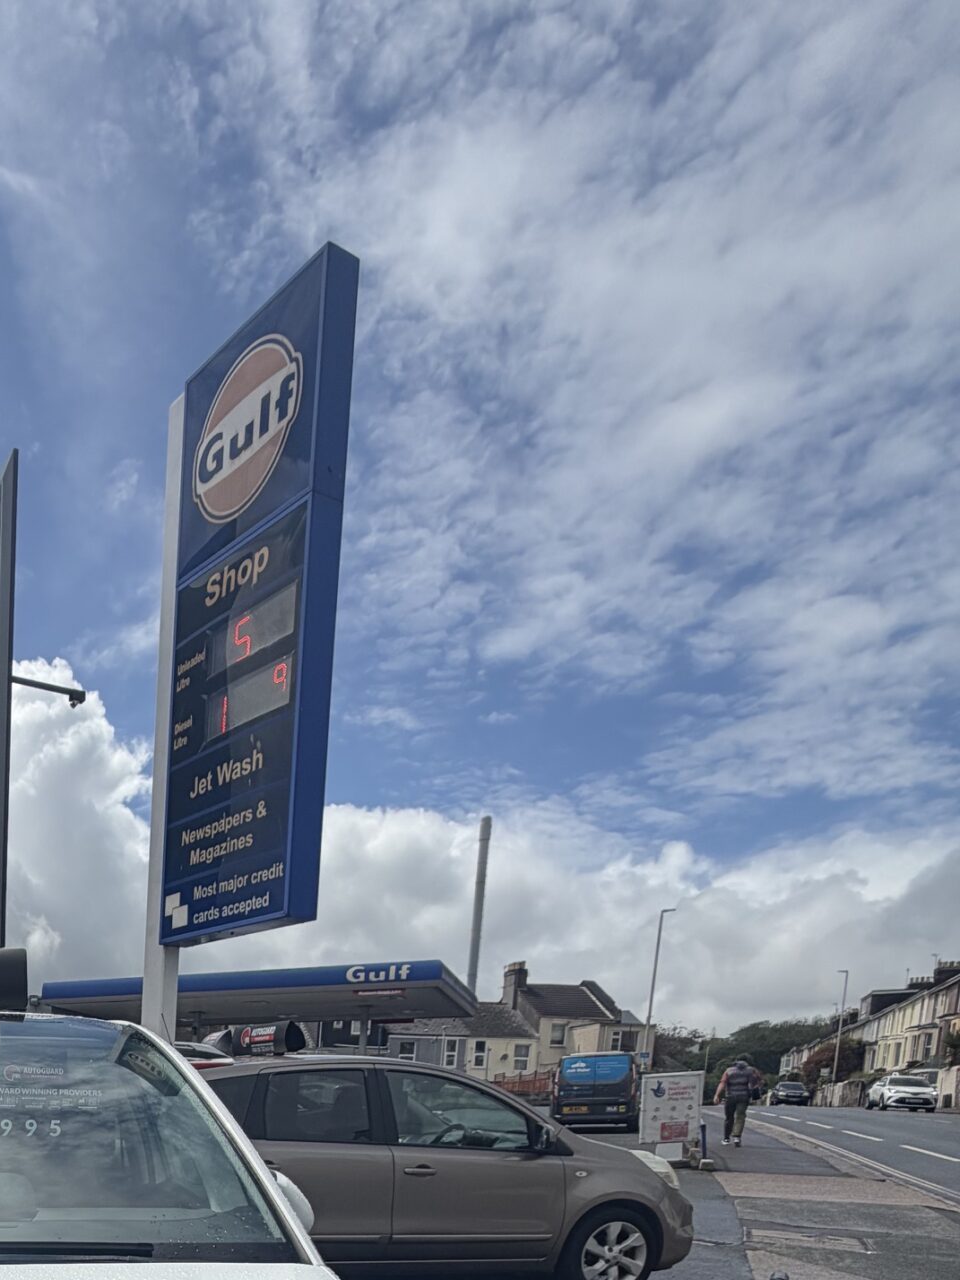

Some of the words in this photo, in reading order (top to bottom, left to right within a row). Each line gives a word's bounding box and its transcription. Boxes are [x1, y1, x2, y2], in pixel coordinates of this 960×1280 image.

[198, 371, 295, 484] Gulf
[205, 546, 269, 607] Shop
[190, 769, 213, 799] Jet
[217, 750, 264, 783] Wash
[181, 808, 253, 846] Newspapers
[256, 799, 268, 819] &
[190, 832, 254, 867] Magazines
[193, 880, 217, 901] Most
[219, 871, 248, 893] major
[250, 861, 285, 886] credit
[193, 904, 219, 925] cards
[221, 891, 270, 920] accepted
[345, 964, 411, 983] Gulf
[21, 1088, 58, 1096] WINNING
[59, 1089, 102, 1097] PROVIDERS
